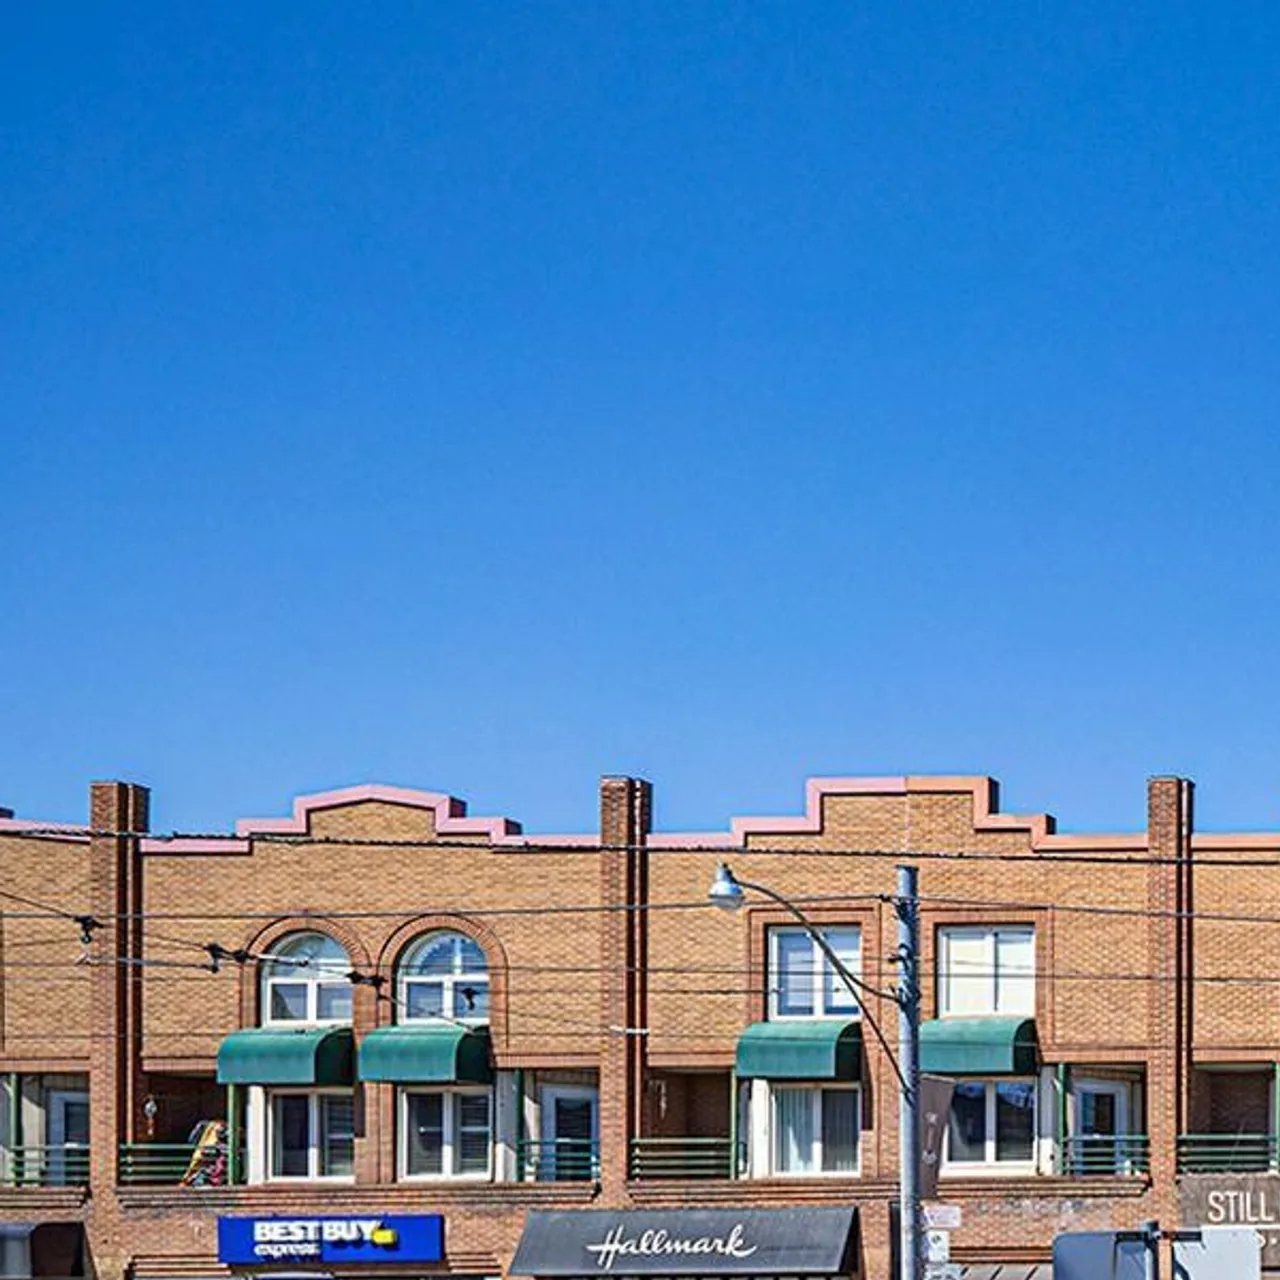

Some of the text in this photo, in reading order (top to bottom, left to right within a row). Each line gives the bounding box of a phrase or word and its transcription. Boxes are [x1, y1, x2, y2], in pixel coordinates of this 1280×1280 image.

[1208, 1190, 1274, 1222] STILL
[254, 1221, 382, 1241] BEST BUY
[586, 1224, 757, 1270] Hallmark
